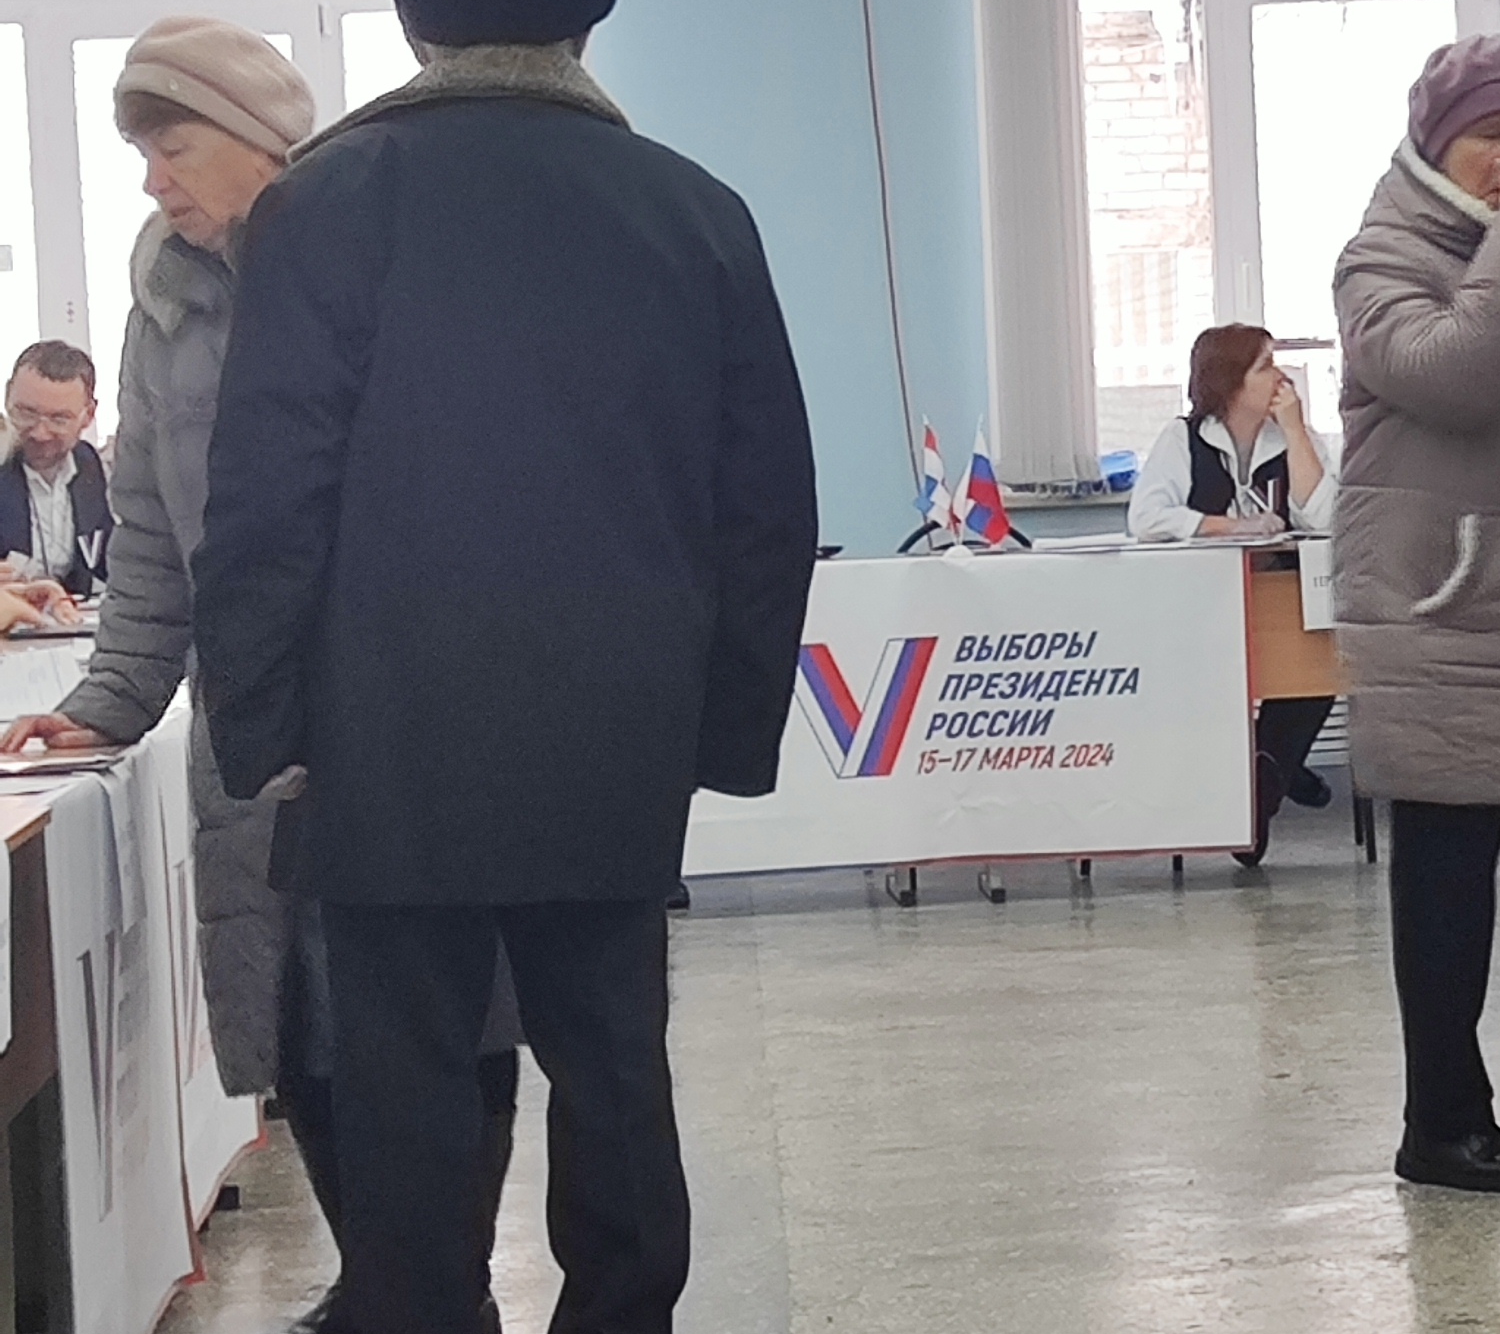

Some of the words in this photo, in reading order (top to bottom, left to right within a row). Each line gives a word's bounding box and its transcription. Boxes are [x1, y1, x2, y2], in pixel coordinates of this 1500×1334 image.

[954, 631, 1098, 662] ВЫБОРЫ
[938, 667, 1140, 702] ПРЕЗИДЕНТА
[925, 709, 1055, 740] РОССИИ
[977, 746, 1055, 771] МАРТА
[1058, 743, 1114, 768] 2024
